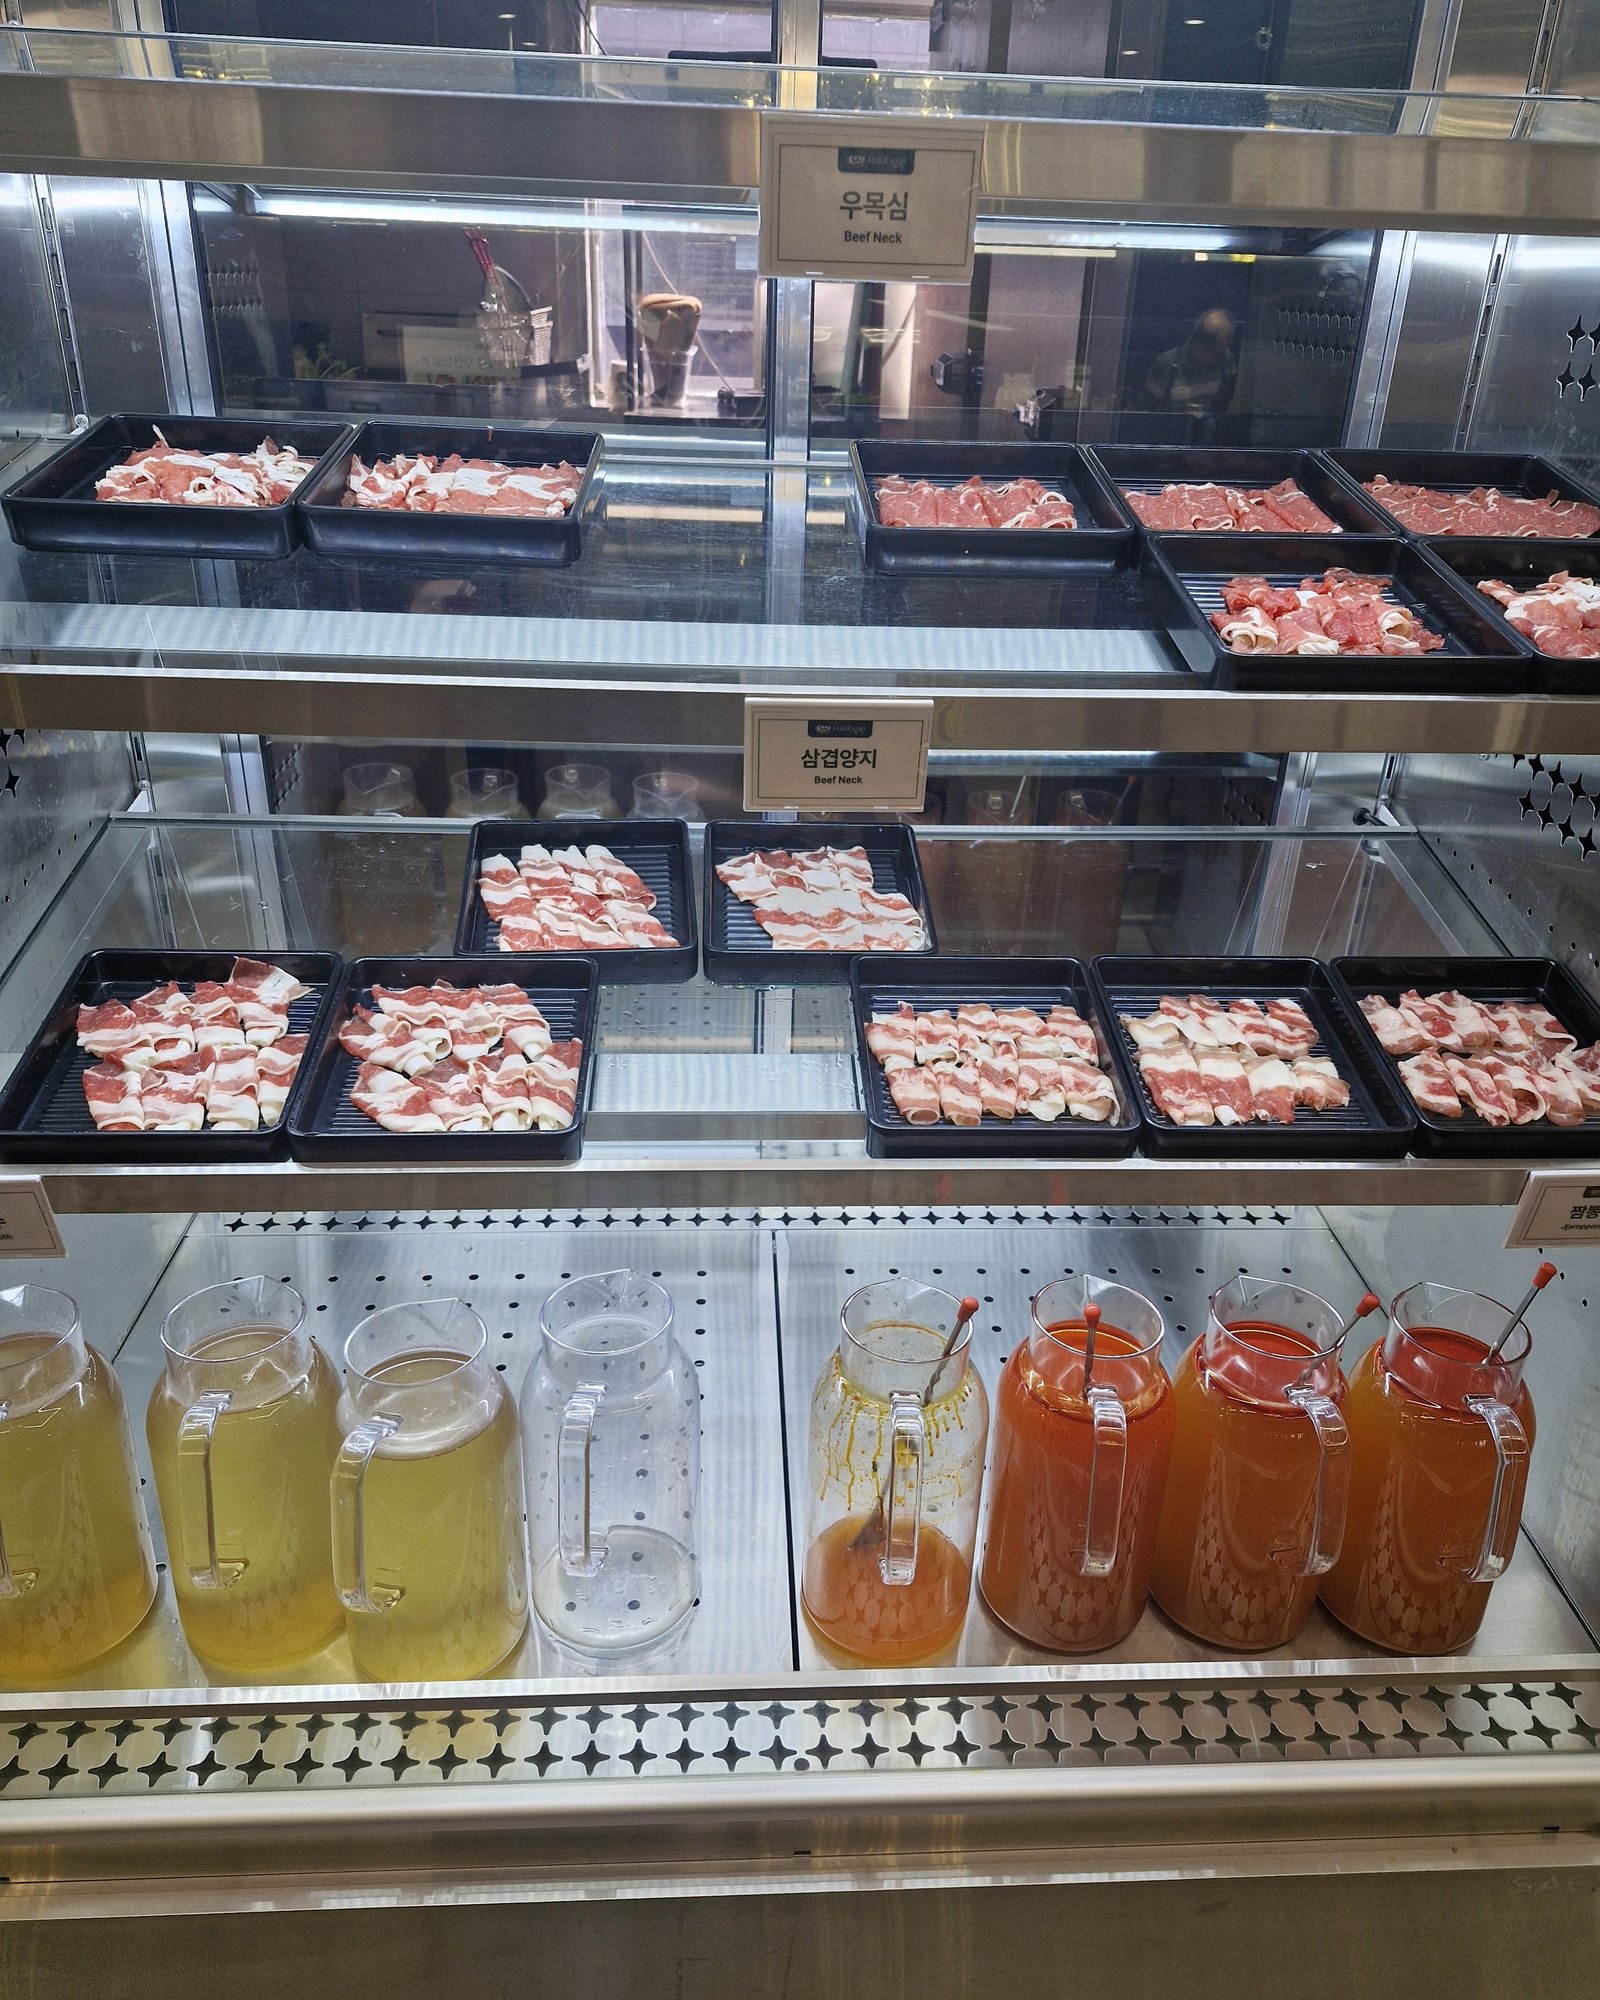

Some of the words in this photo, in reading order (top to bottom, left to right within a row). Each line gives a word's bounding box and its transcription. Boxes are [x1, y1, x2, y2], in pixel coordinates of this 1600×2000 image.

[839, 190, 909, 221] 우목심
[844, 230, 870, 243] Beef
[873, 231, 902, 244] Neck
[801, 748, 877, 769] 삼겹양지
[814, 775, 836, 785] Beef
[838, 775, 863, 785] Neck
